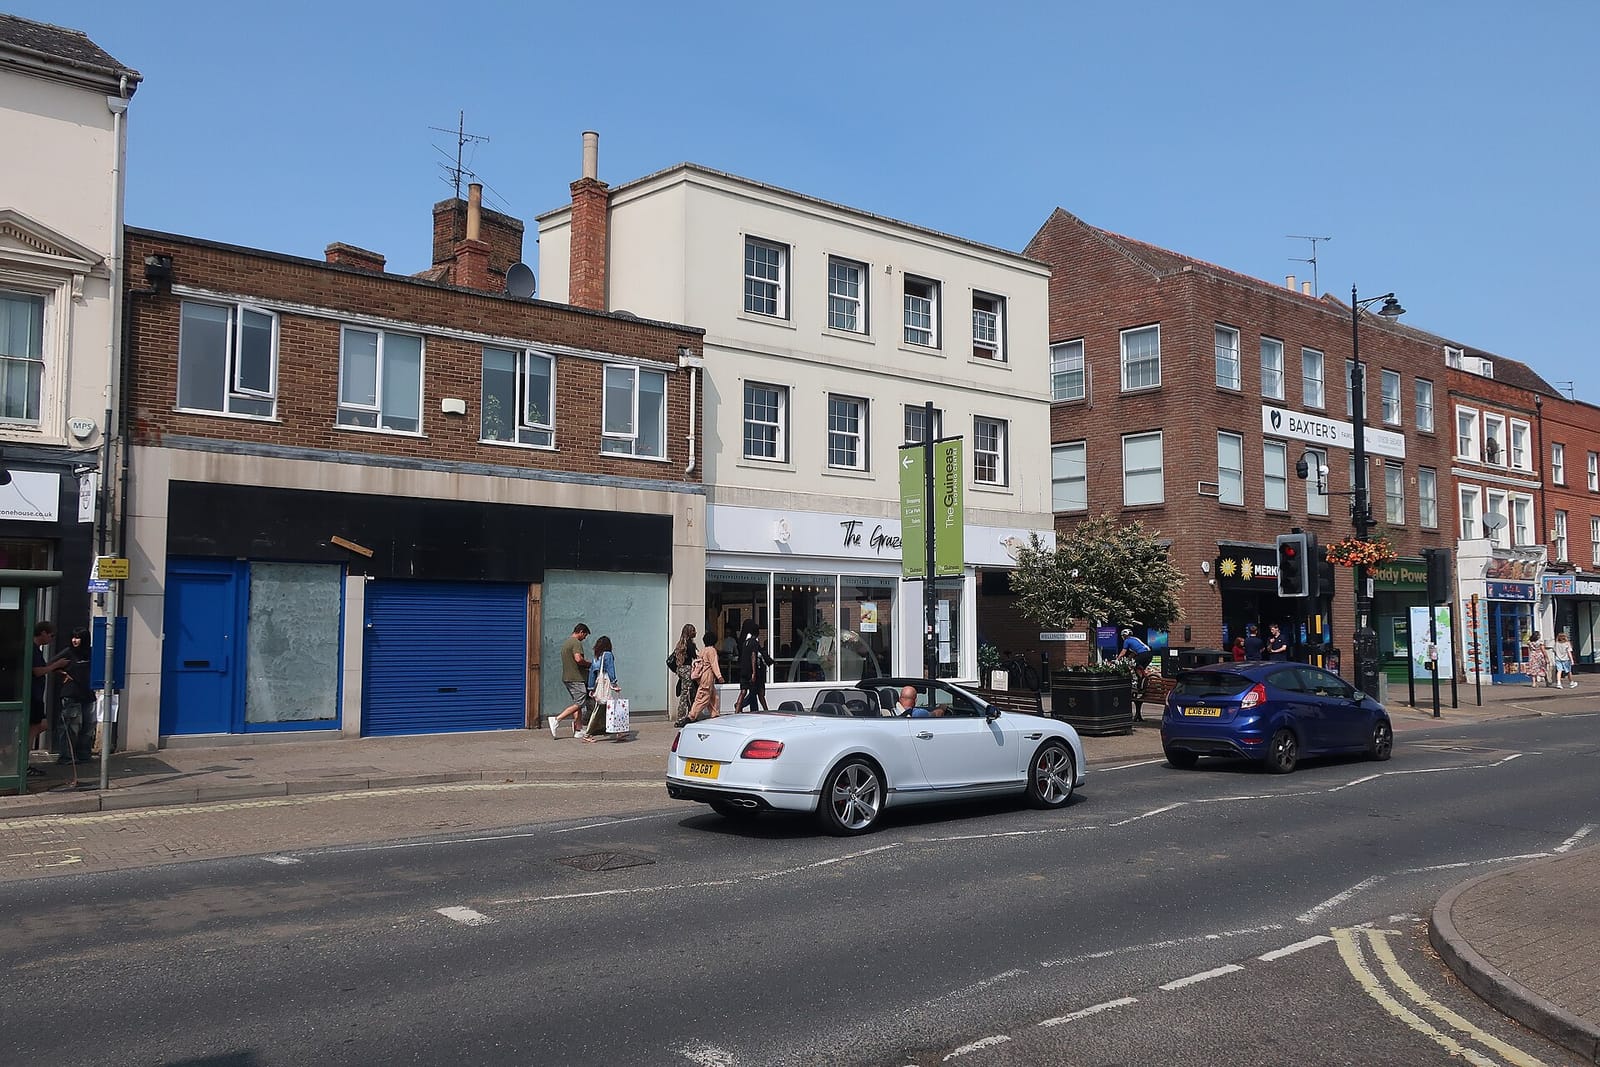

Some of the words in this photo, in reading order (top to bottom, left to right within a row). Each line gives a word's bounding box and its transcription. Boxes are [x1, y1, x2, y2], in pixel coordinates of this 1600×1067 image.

[73, 422, 92, 430] MPS
[1289, 417, 1337, 440] BAXTER'S
[943, 447, 954, 507] Guineas
[945, 507, 955, 529] The
[840, 520, 863, 547] The
[1254, 564, 1280, 577] MERK
[1373, 568, 1399, 585] addy
[1401, 567, 1428, 583] Powe
